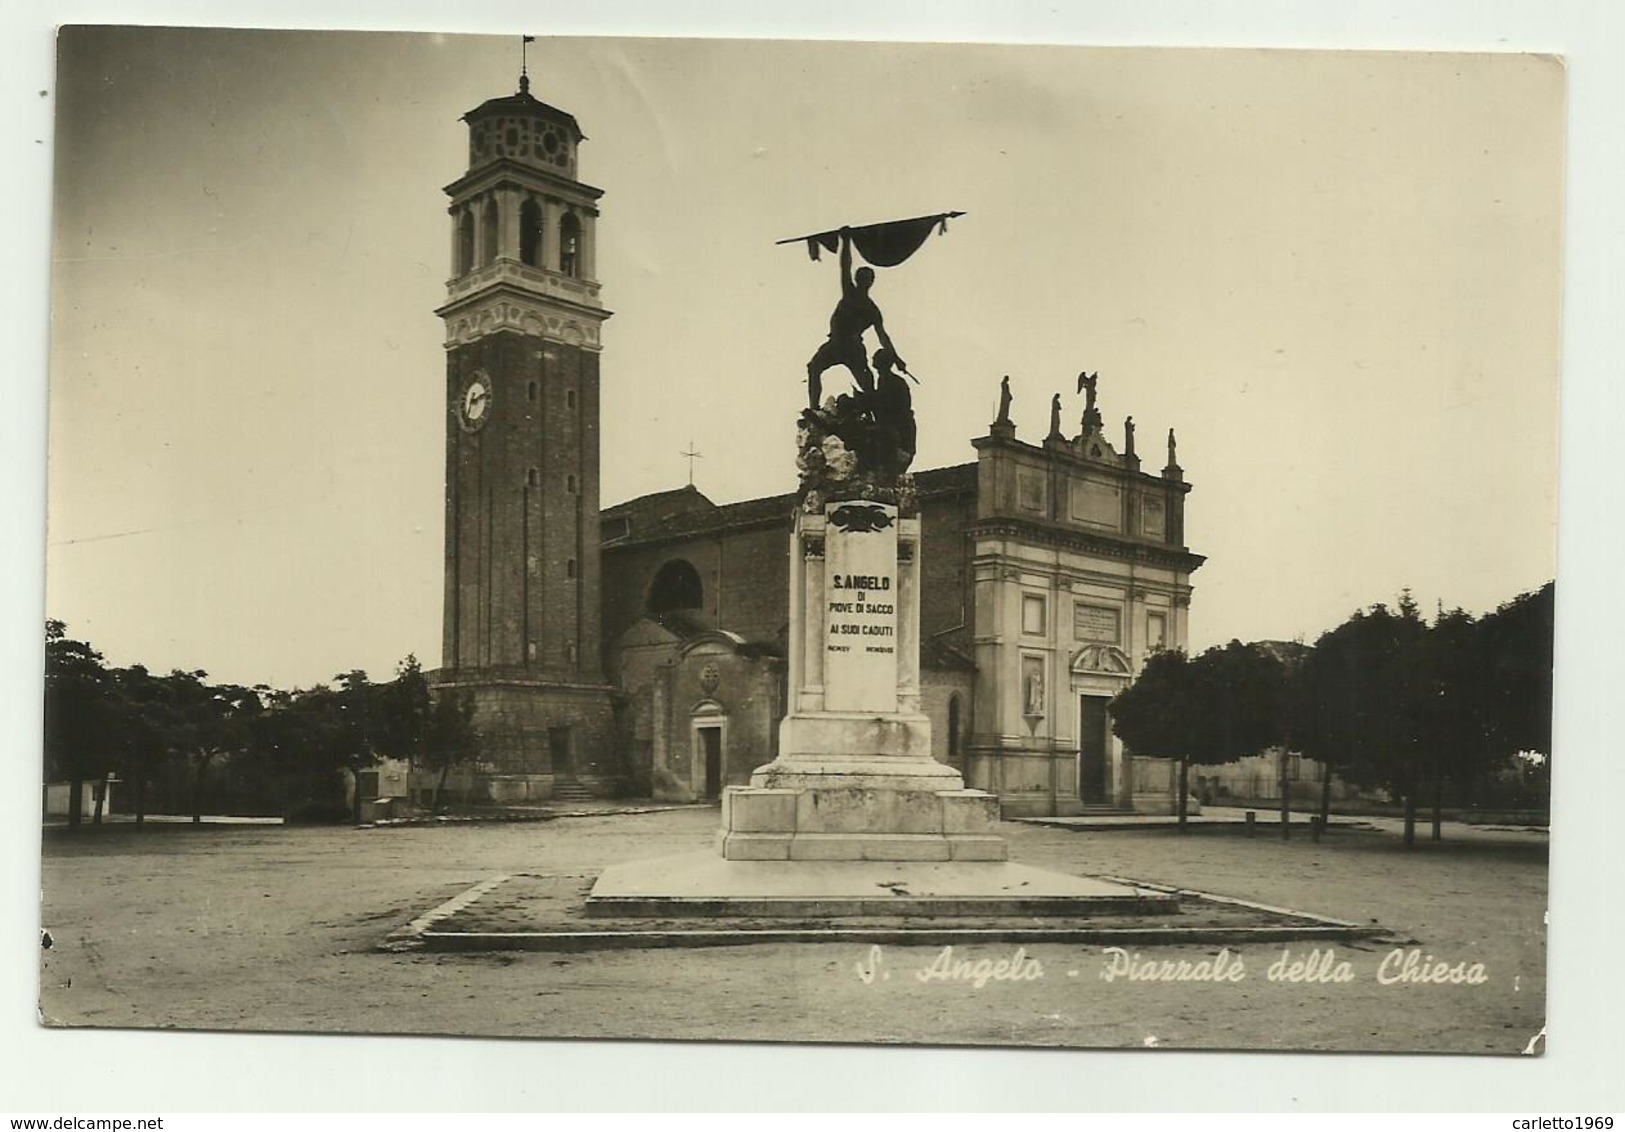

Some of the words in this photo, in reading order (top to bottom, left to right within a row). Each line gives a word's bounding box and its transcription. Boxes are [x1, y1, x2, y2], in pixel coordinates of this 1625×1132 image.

[858, 591, 865, 601] DI
[829, 602, 853, 613] PIOVE
[856, 603, 864, 613] DI
[866, 604, 894, 614] SACCO
[830, 624, 839, 634] AI
[841, 624, 860, 635] SUOI
[862, 625, 893, 636] CADUTI
